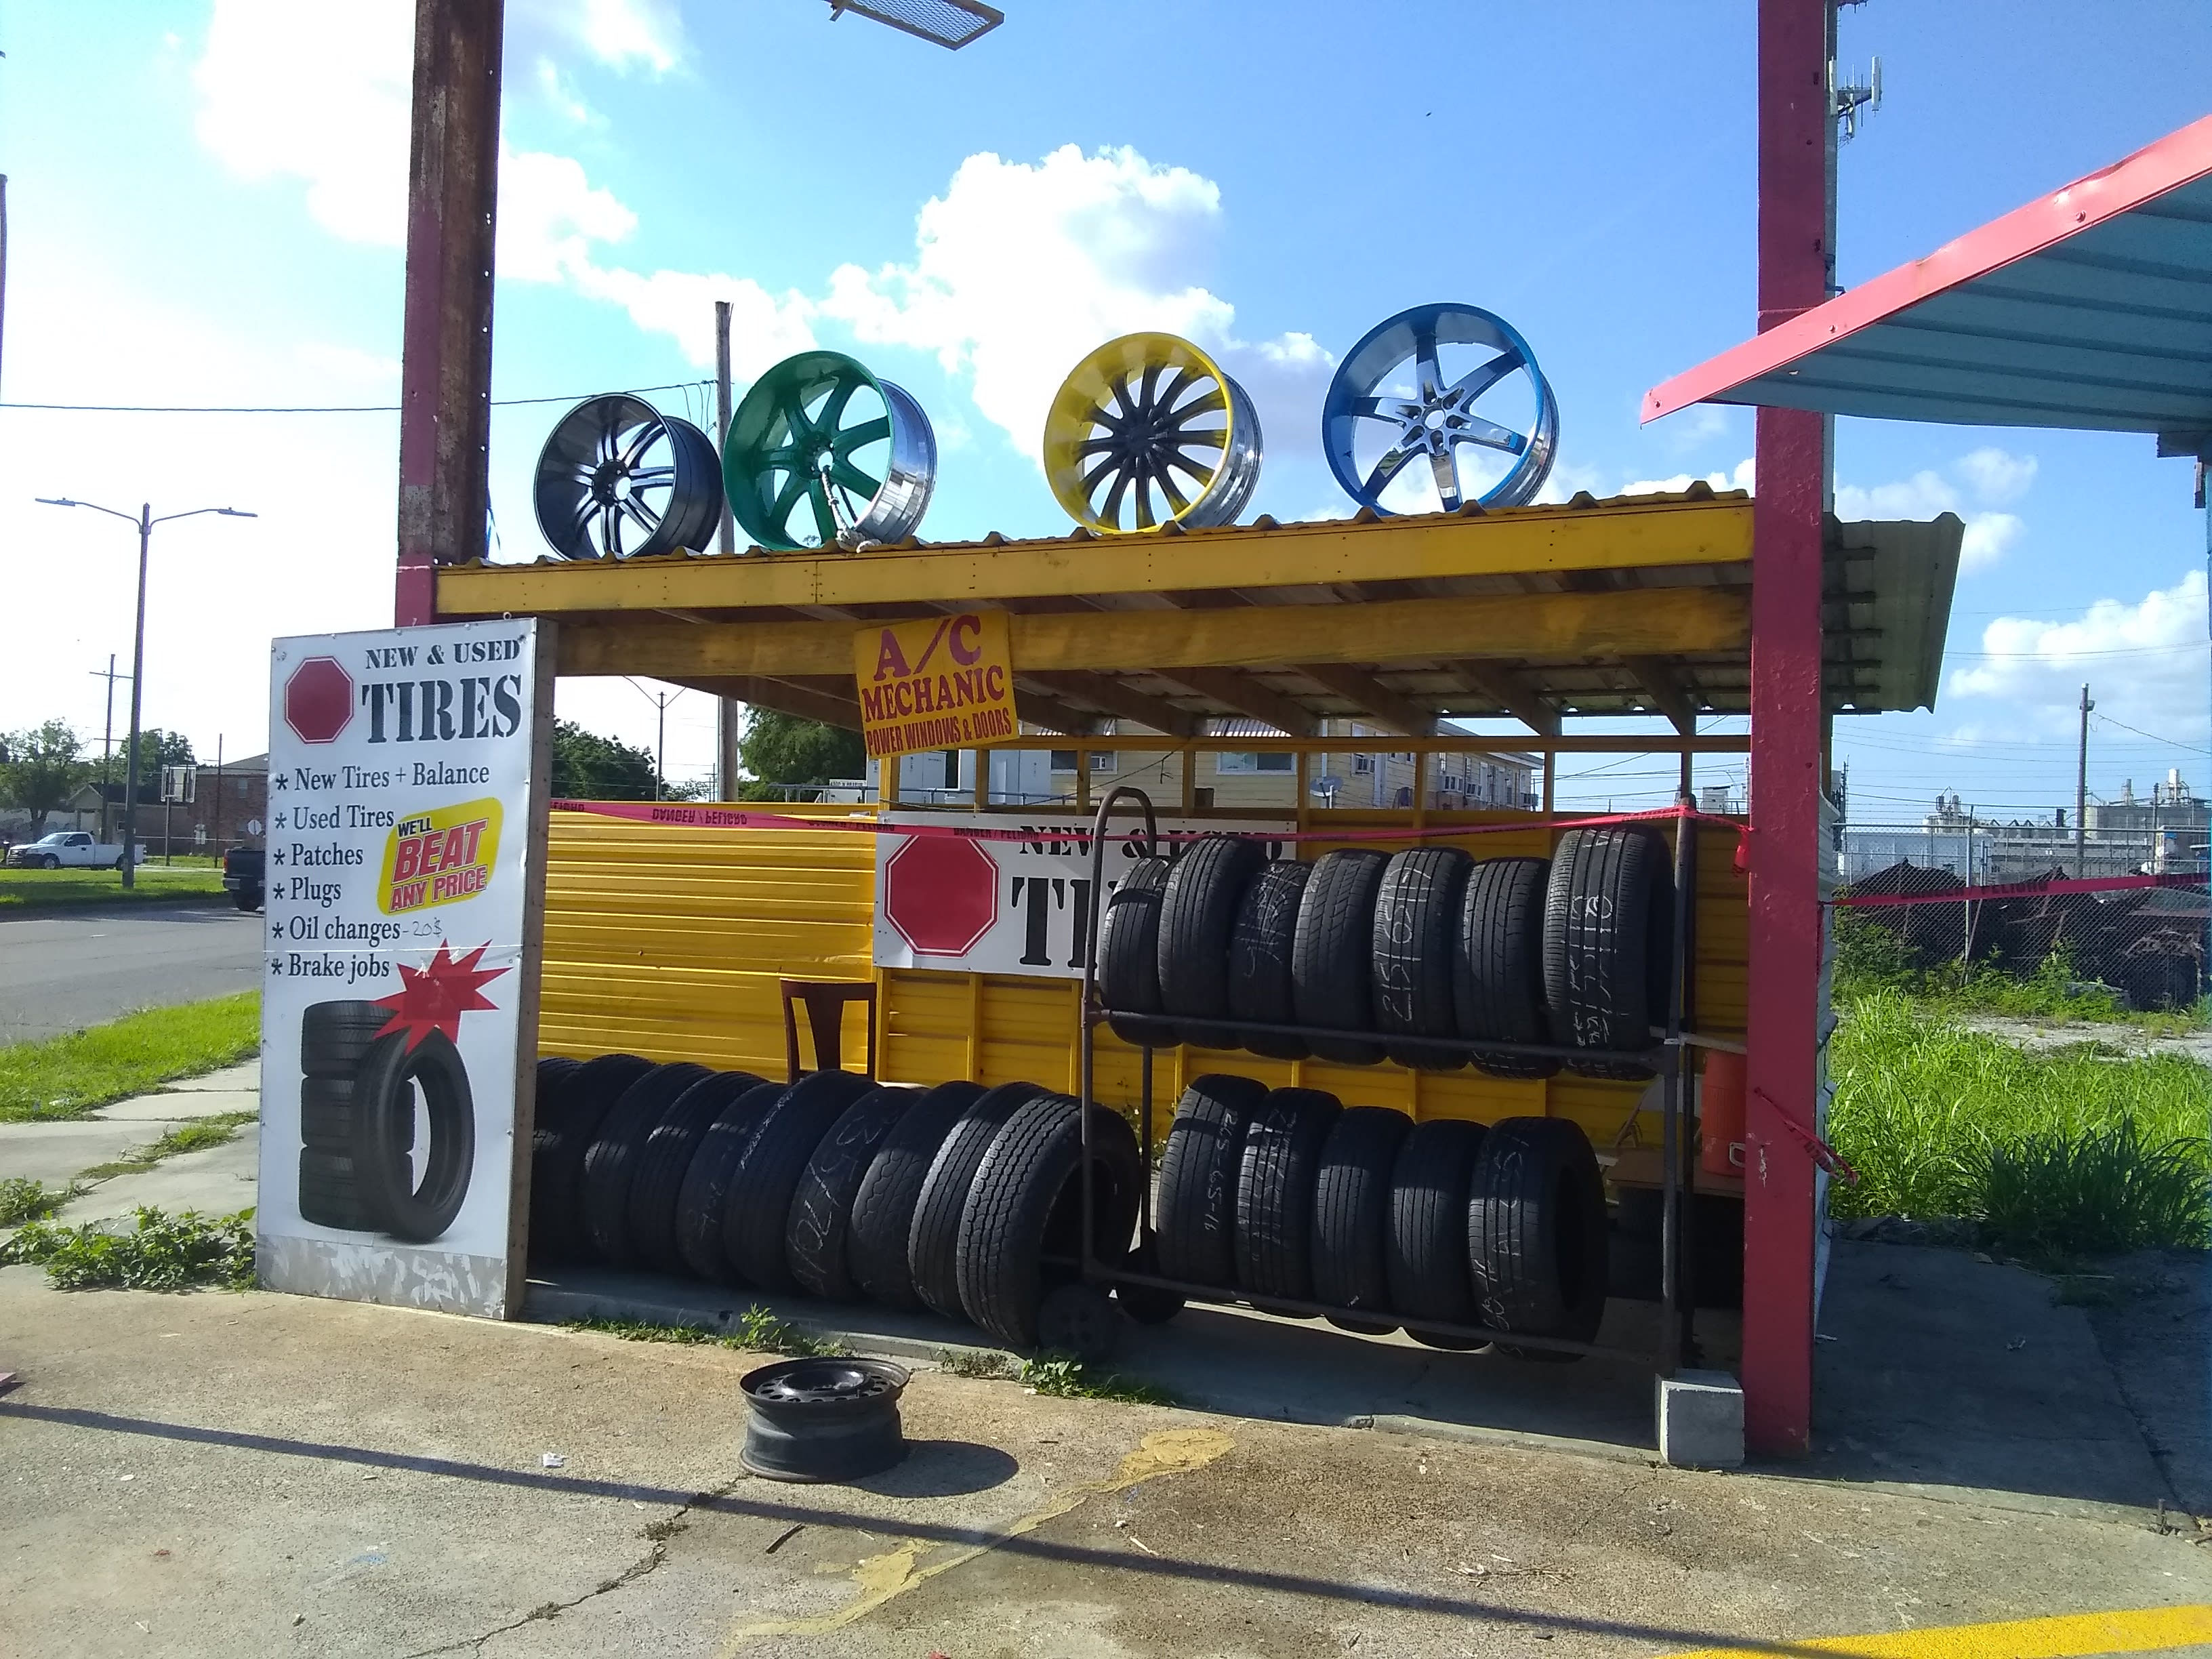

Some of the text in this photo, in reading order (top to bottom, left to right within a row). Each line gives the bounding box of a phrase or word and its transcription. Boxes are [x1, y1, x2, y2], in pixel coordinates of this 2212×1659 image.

[365, 639, 520, 670] NEW & USED
[874, 615, 981, 681] A/C
[361, 674, 522, 743] TIRES
[861, 665, 1005, 722] MECHANIC
[867, 708, 1012, 756] POWER WINDOWS & DOORS
[294, 767, 336, 791] New
[342, 766, 390, 789] Tires
[412, 761, 489, 786] Balance
[293, 804, 394, 830] Used Tires
[398, 817, 432, 838] WE'LL
[291, 842, 363, 866] Patches
[391, 818, 489, 885] BEAT
[290, 877, 342, 908] Plugs
[389, 864, 488, 913] ANY PRICE
[289, 916, 401, 947] Oil changes
[288, 953, 390, 985] Brake jobs
